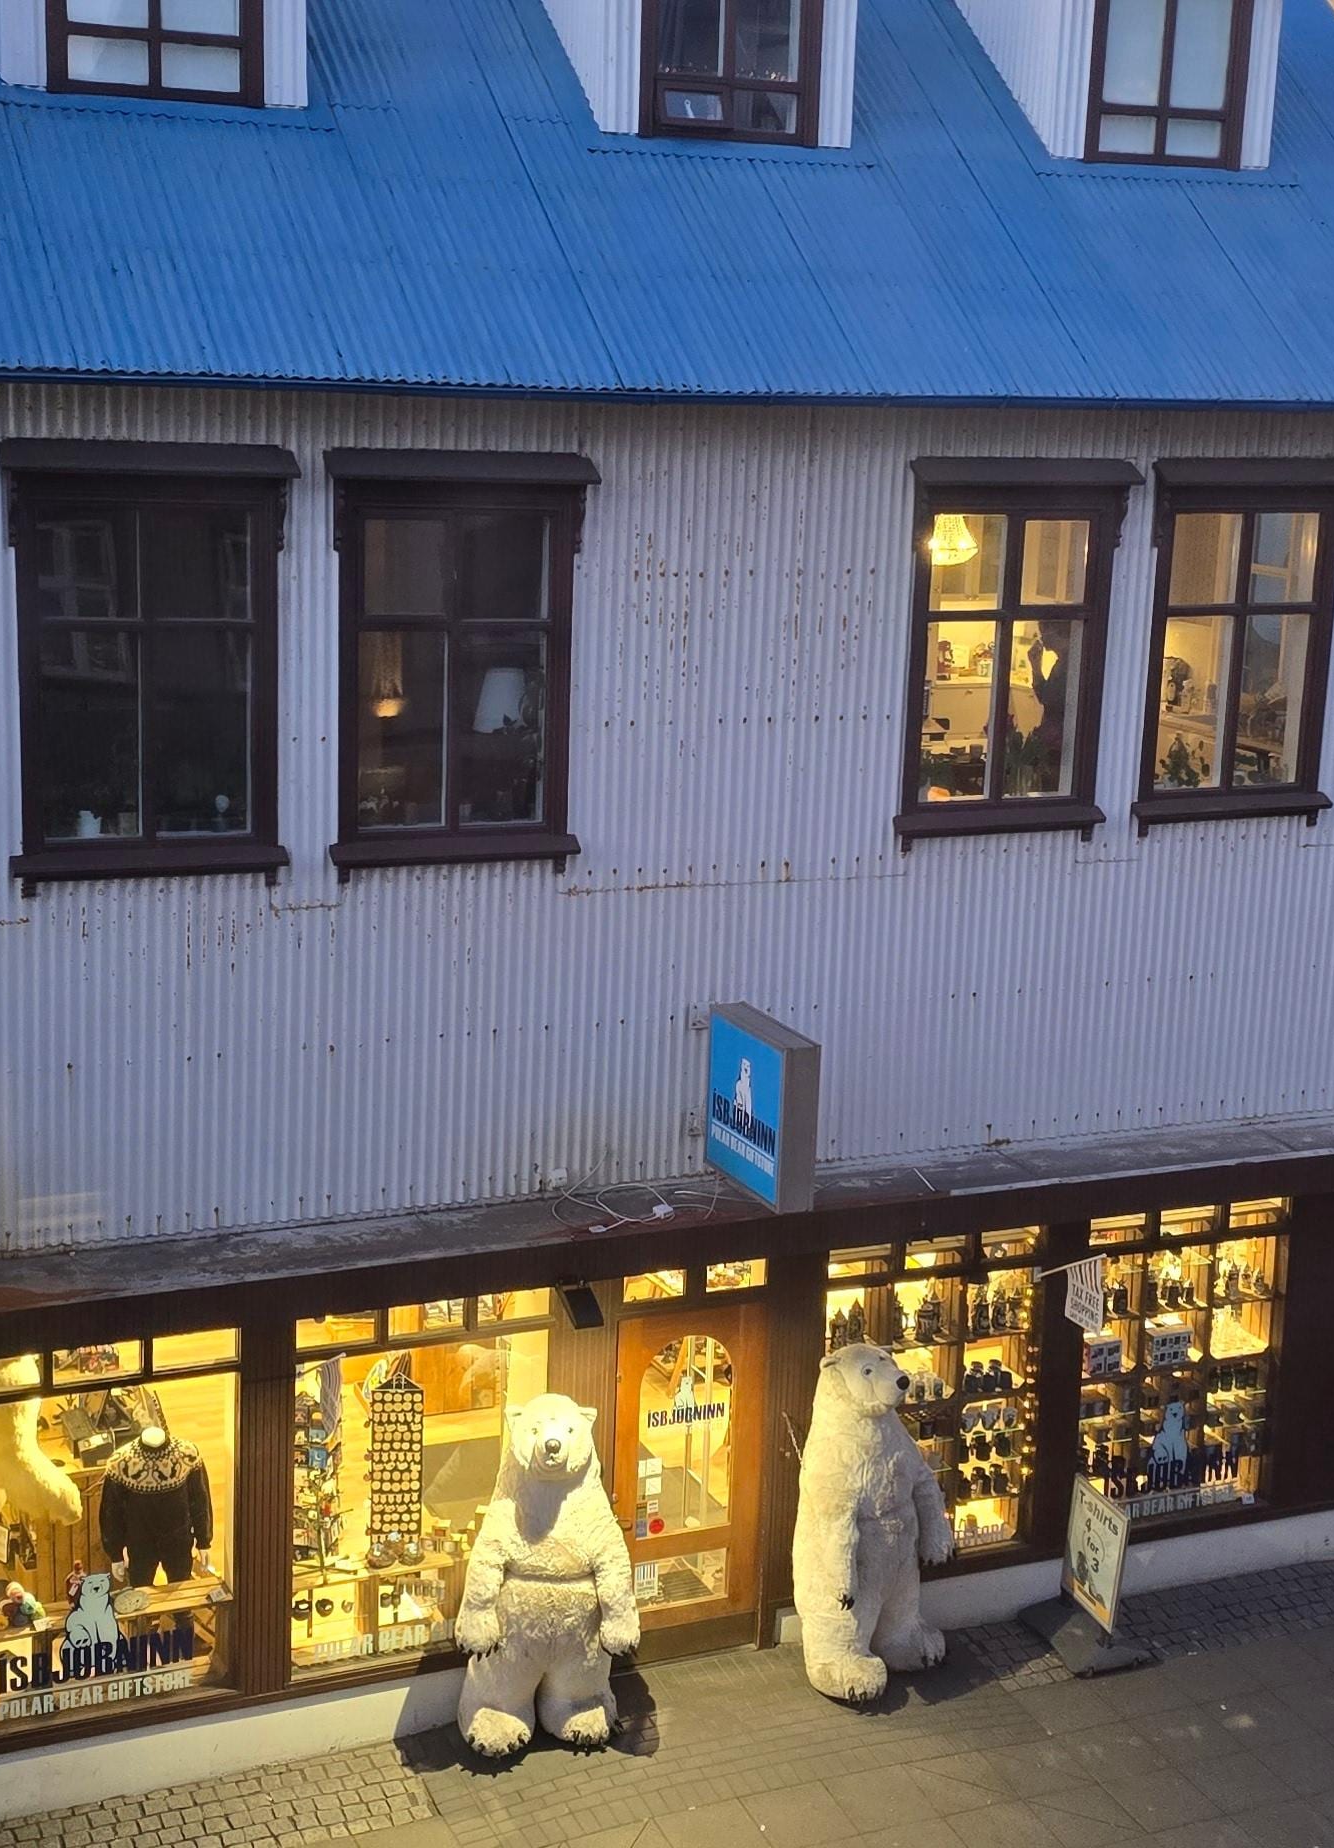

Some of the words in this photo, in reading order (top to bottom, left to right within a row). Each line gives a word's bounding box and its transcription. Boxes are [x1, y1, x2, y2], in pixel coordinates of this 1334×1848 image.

[1078, 1489, 1120, 1537] T-shirts
[1142, 1495, 1175, 1517] BEAR
[1085, 1517, 1092, 1533] 4
[1085, 1536, 1100, 1555] for
[1090, 1557, 1100, 1574] 3
[378, 1623, 429, 1652] BEAR
[59, 1684, 105, 1711] BEAR
[107, 1670, 194, 1702] GIFTSTORE
